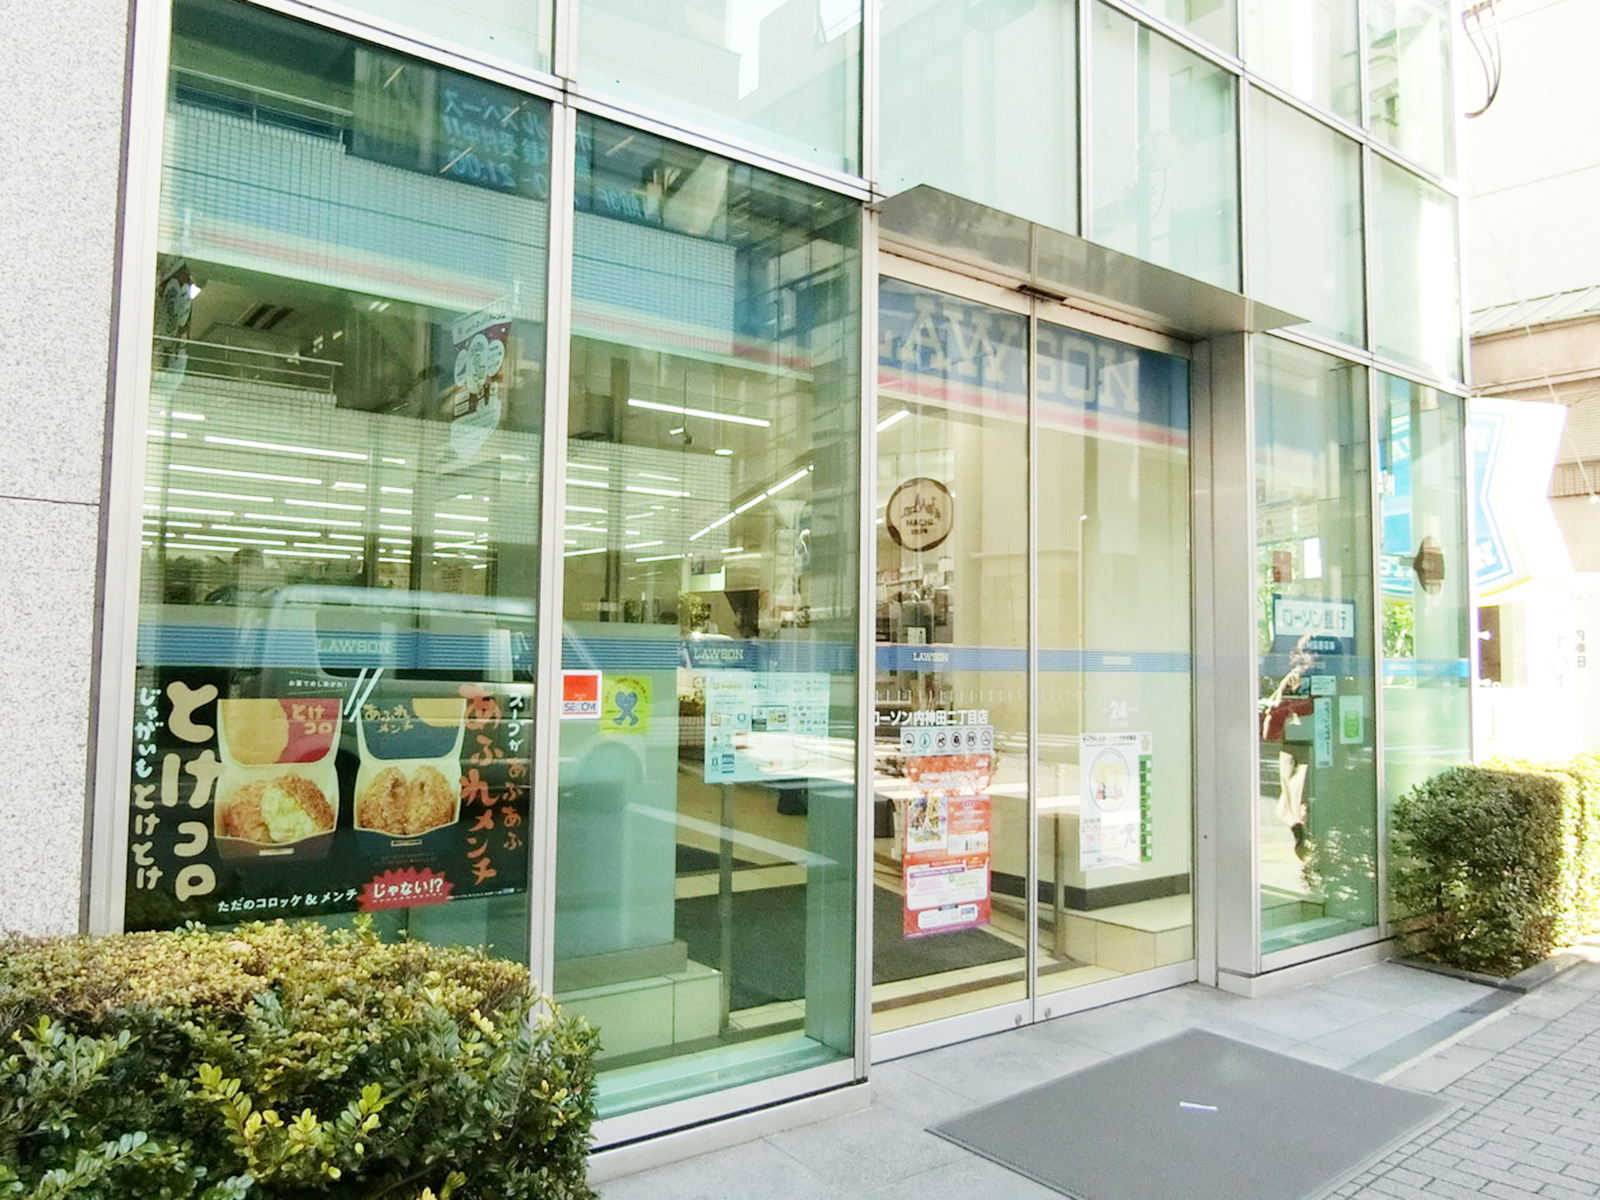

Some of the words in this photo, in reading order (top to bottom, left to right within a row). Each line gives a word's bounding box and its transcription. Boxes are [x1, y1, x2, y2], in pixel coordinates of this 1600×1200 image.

[316, 638, 393, 654] LAWSON
[291, 703, 325, 720] とけ
[564, 702, 596, 711] SECOM
[1109, 701, 1128, 719] 24
[161, 681, 226, 902] とけコロ
[218, 894, 302, 912] ただのコロッケ
[320, 887, 358, 904] メンチ
